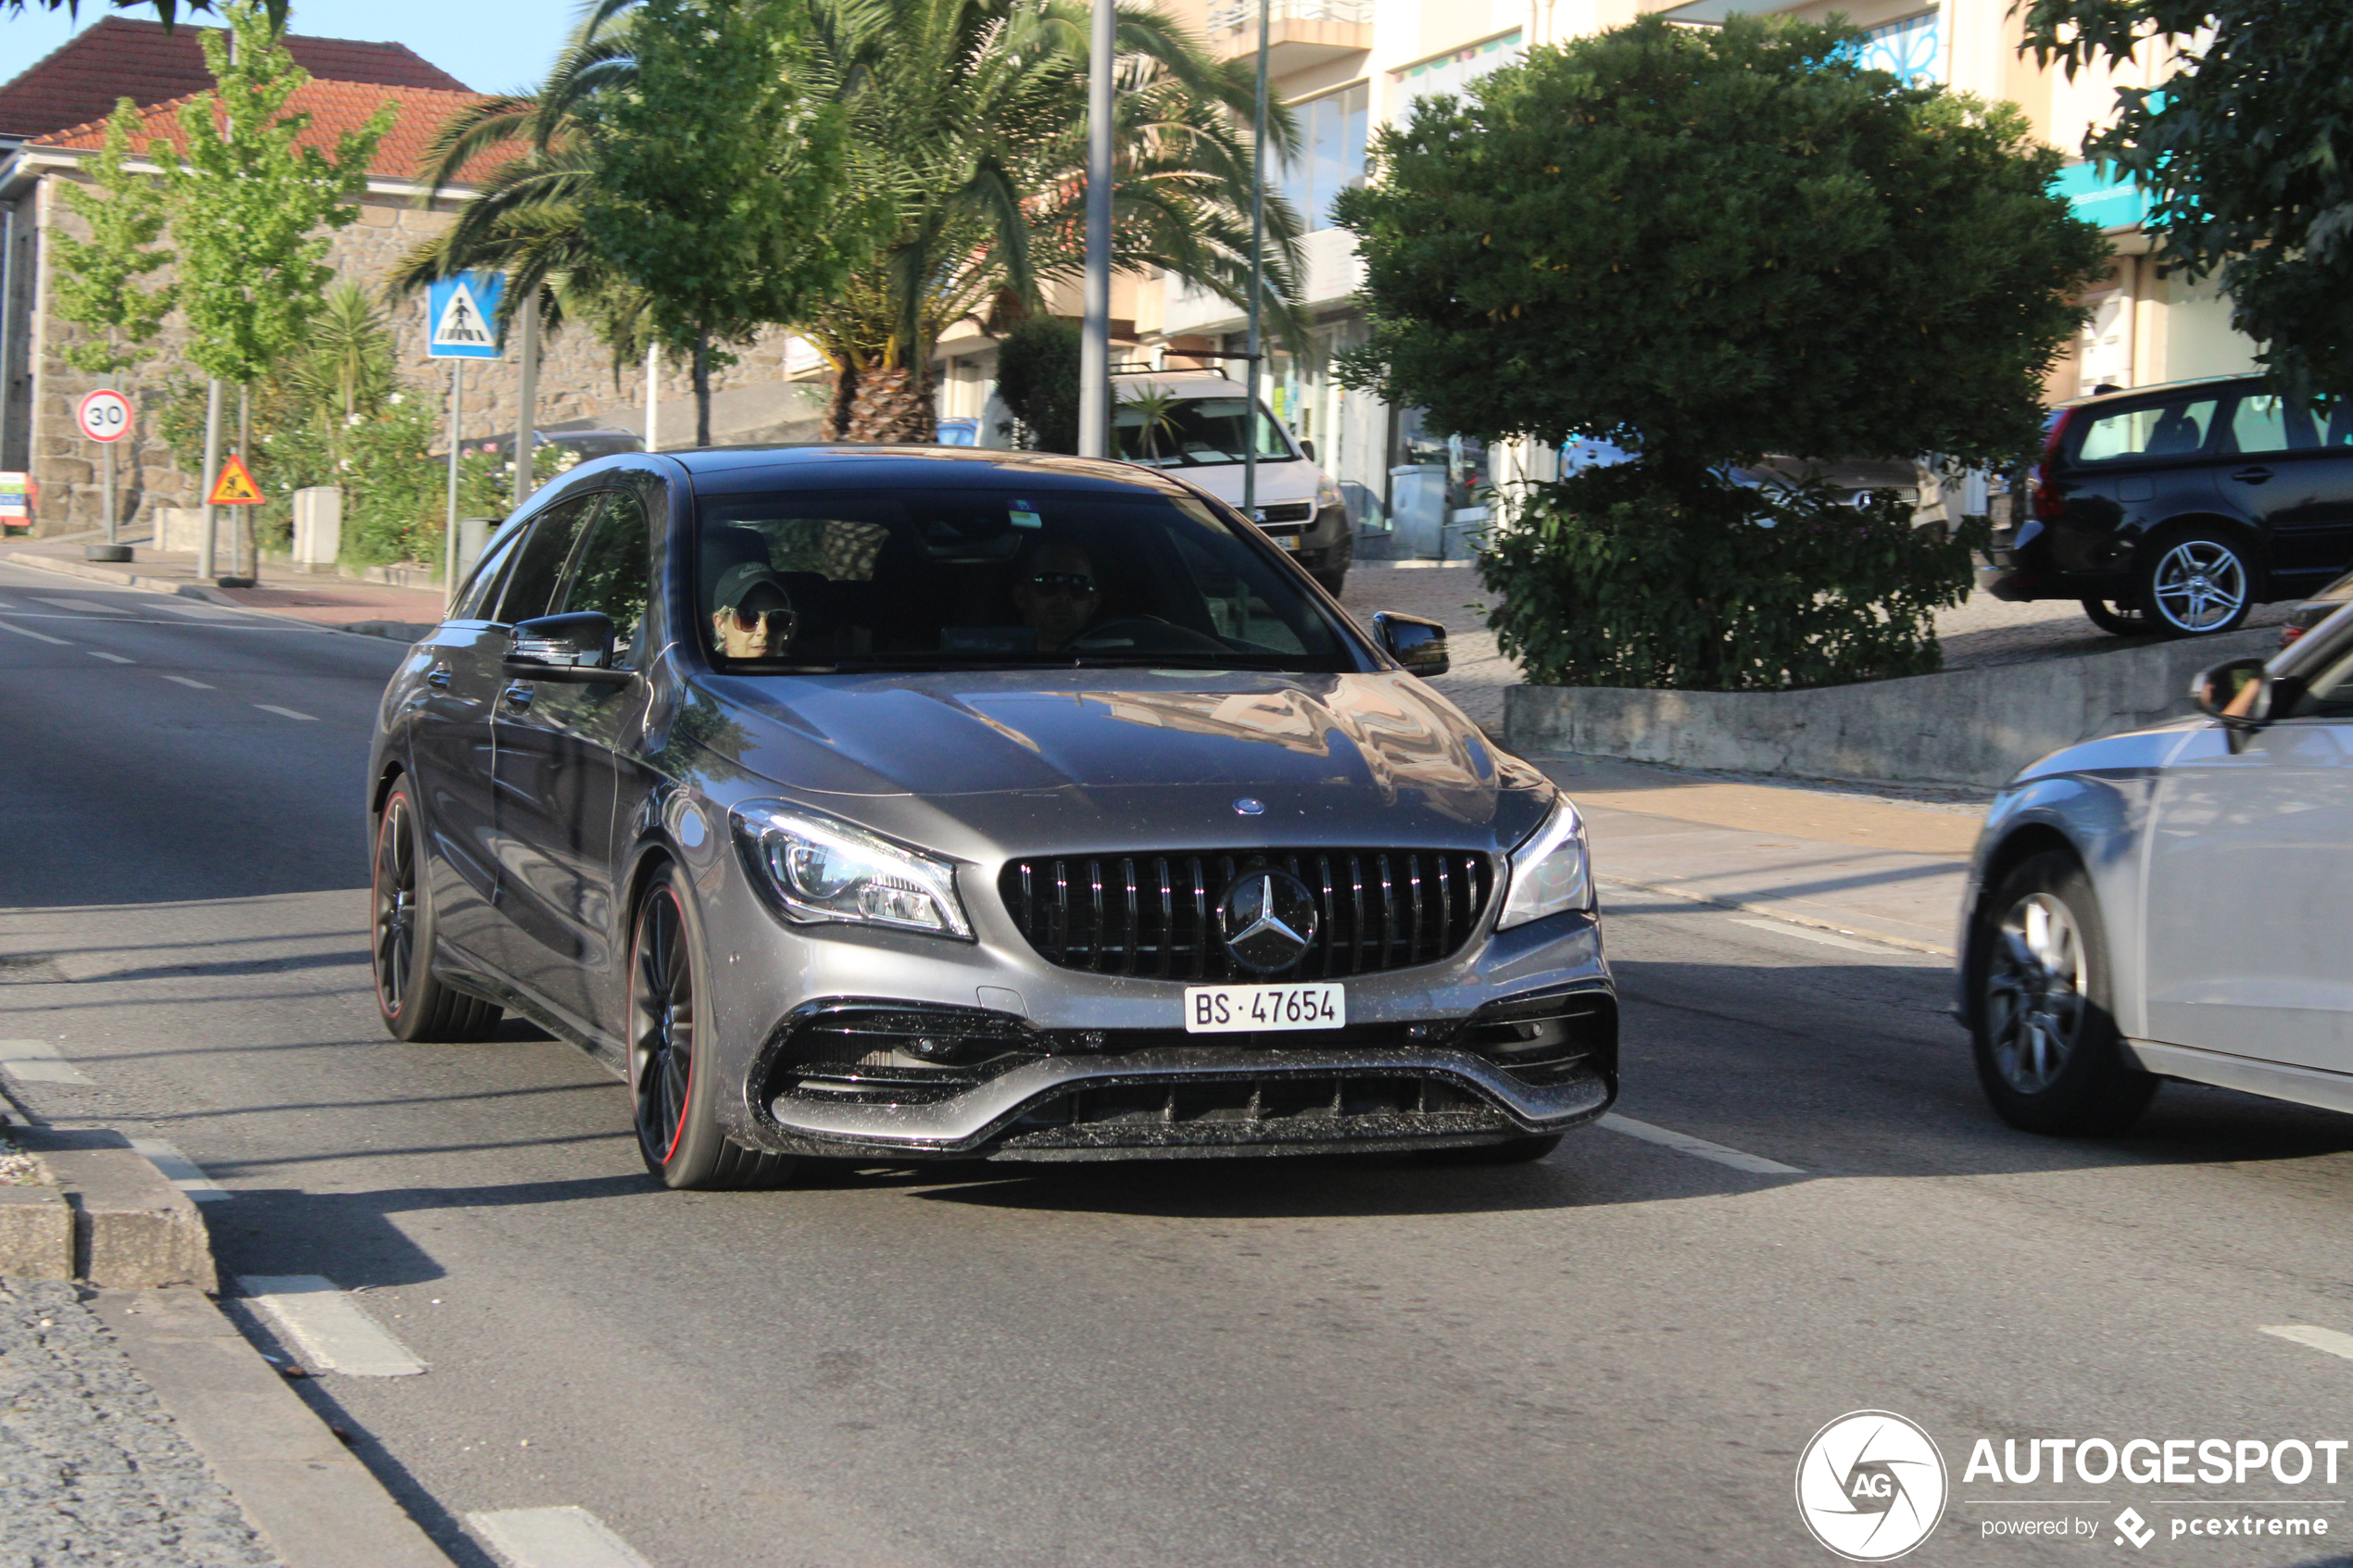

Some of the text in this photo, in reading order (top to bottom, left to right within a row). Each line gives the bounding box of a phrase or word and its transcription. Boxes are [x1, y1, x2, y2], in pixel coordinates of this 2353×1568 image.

[89, 406, 122, 426] 30
[1195, 990, 1335, 1025] BS 47654
